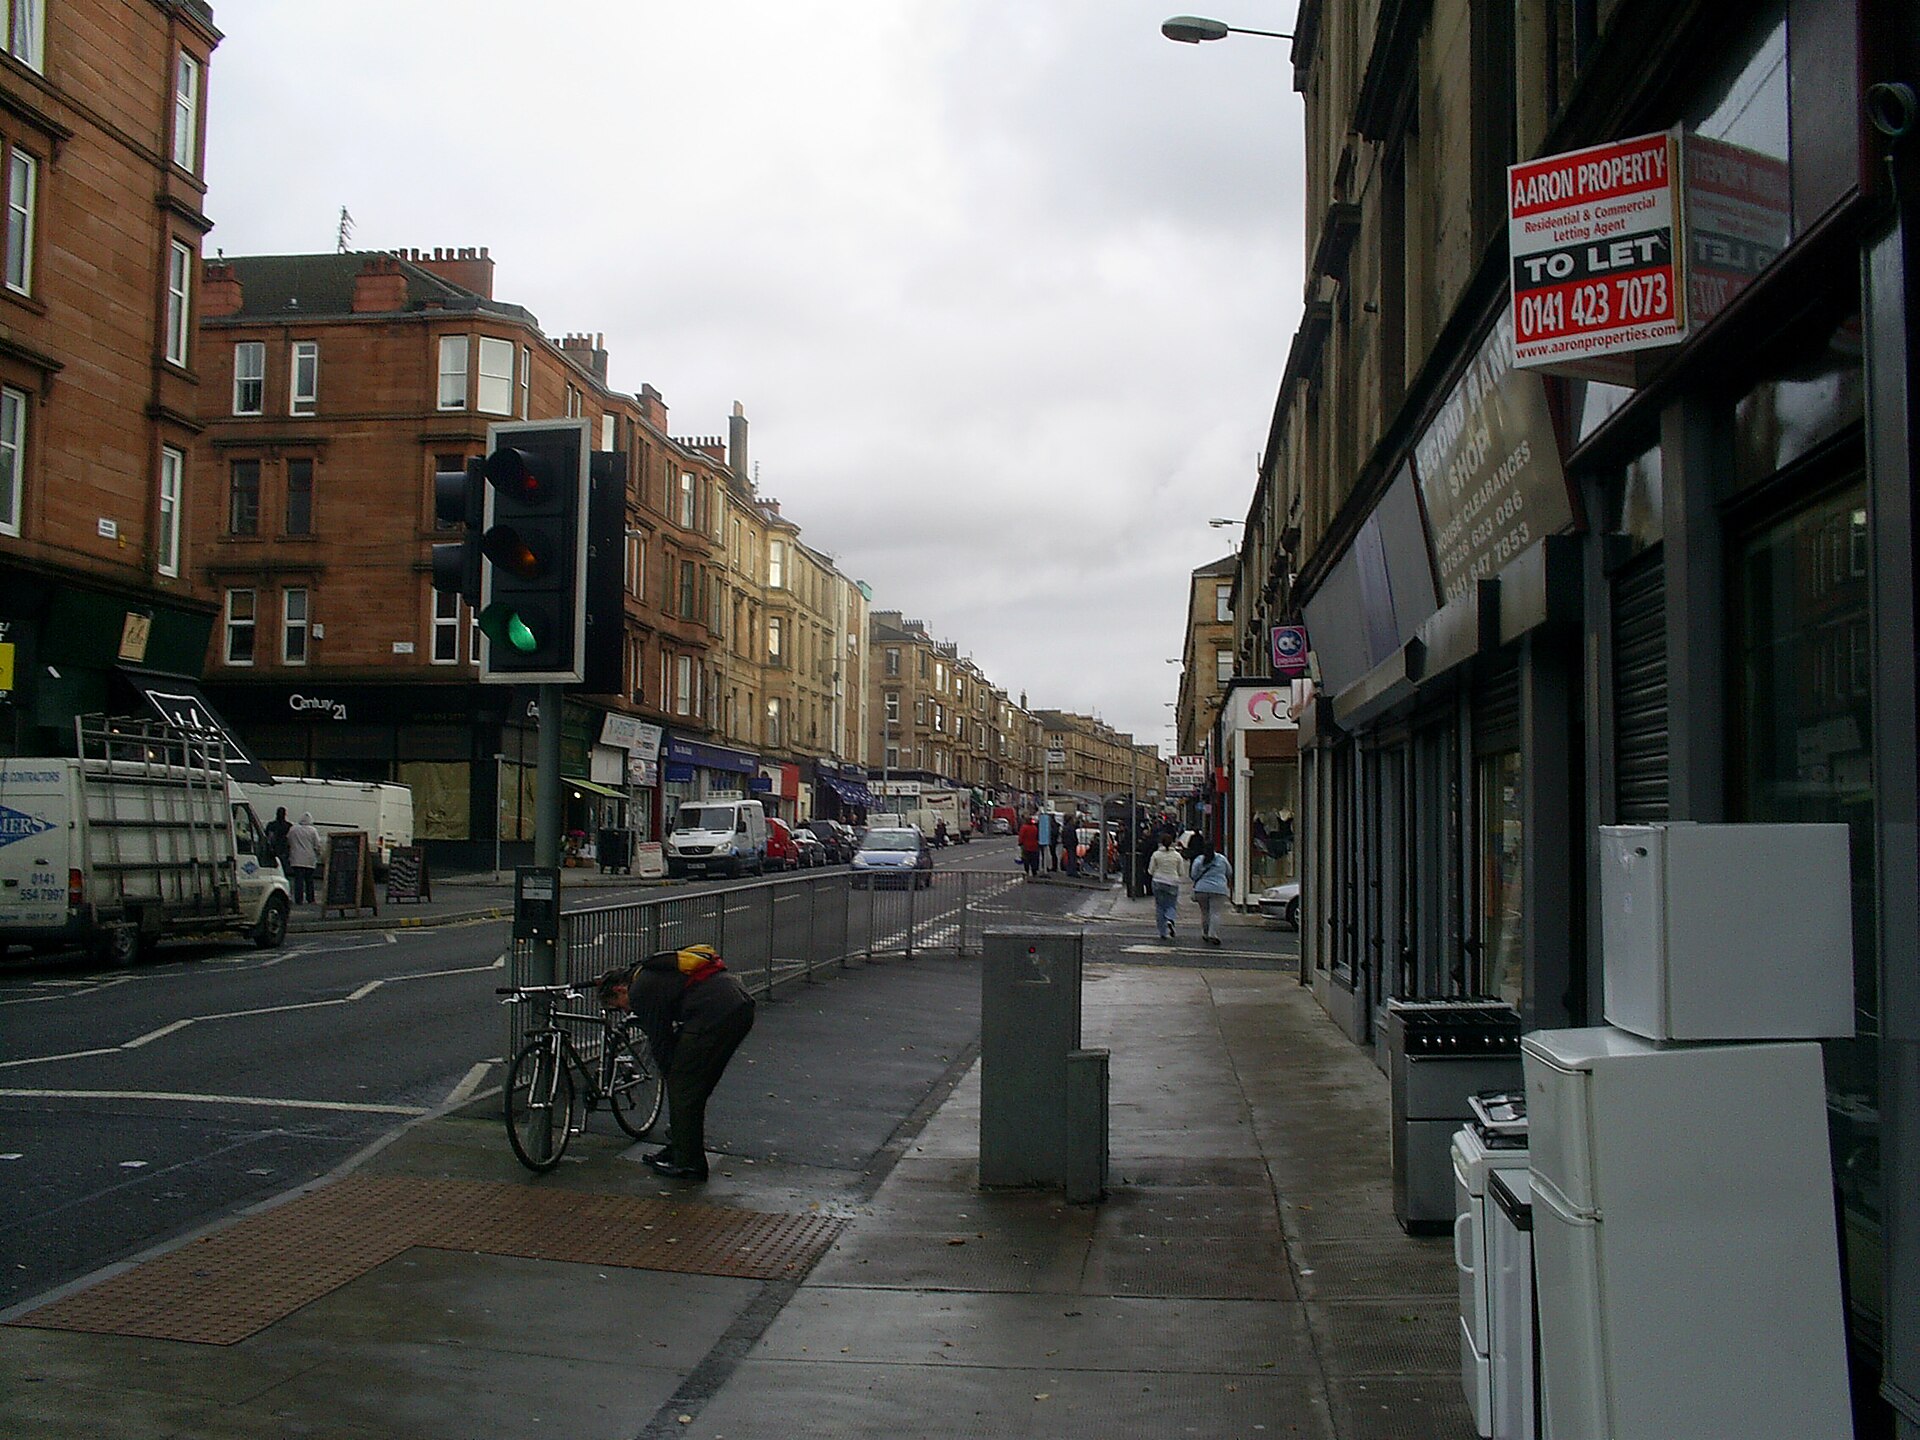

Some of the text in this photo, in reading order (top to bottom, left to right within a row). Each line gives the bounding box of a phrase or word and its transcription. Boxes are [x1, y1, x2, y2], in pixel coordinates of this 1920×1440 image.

[1513, 167, 1574, 209] AARON
[1577, 147, 1666, 195] PROPERTY
[1524, 195, 1656, 234] Residential & Commercial
[1553, 218, 1626, 242] Letting Agent
[1523, 235, 1659, 283] TO LET
[1520, 290, 1565, 337] 0141
[1571, 283, 1610, 327] 423
[1616, 272, 1668, 321] 7073
[1515, 324, 1676, 359] www.aaronproperties.com
[1449, 428, 1487, 498] SHOP
[1463, 440, 1531, 523] CLEARANCES
[1495, 490, 1524, 527] 086
[1493, 521, 1530, 562] 7853
[289, 694, 348, 720] Century 21
[1171, 756, 1205, 766] TO LET
